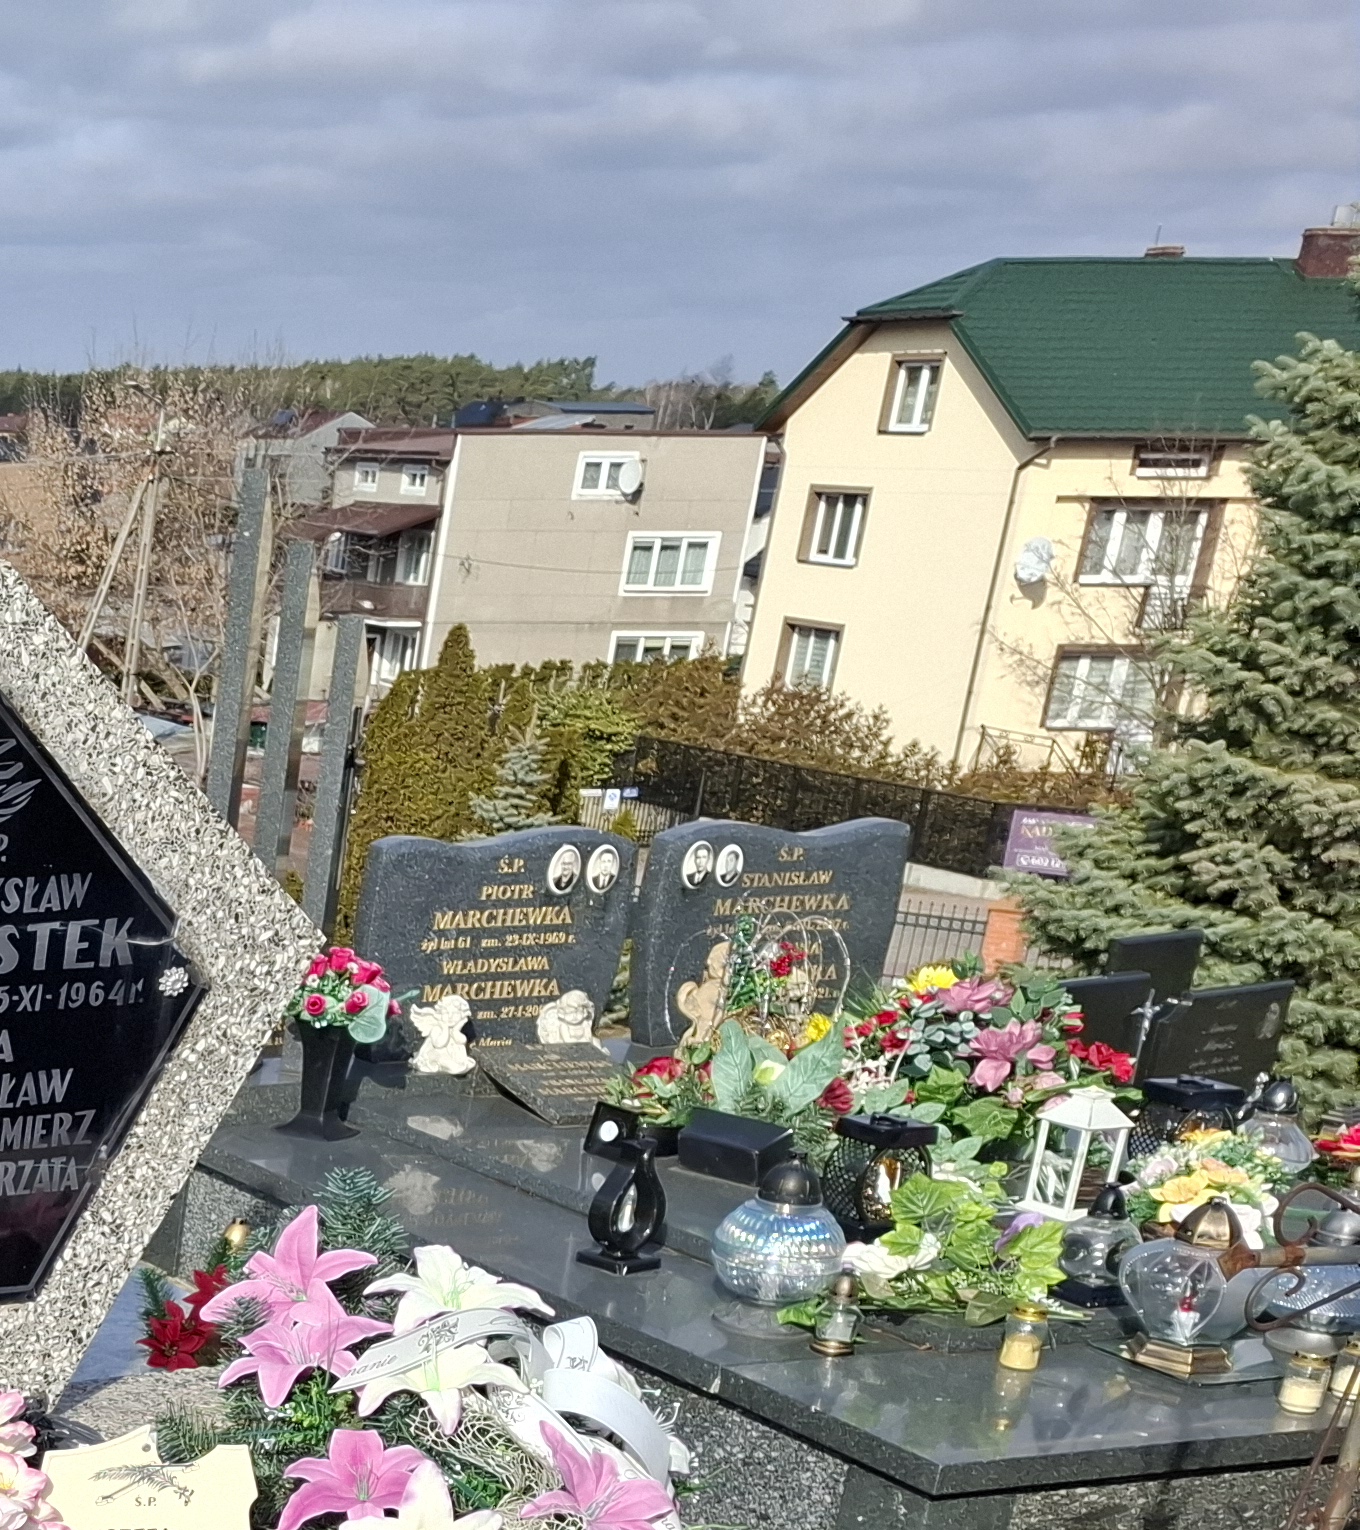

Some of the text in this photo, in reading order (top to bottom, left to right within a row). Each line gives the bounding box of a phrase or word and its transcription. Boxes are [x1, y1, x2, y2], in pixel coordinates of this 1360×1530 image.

[480, 884, 534, 901] PIOTR
[713, 893, 851, 917] MARCHEWKA
[433, 905, 573, 931] MARCHEWKA
[442, 956, 550, 975] WŁADYSŁAWA
[421, 978, 561, 1003] MARCHEWKA
